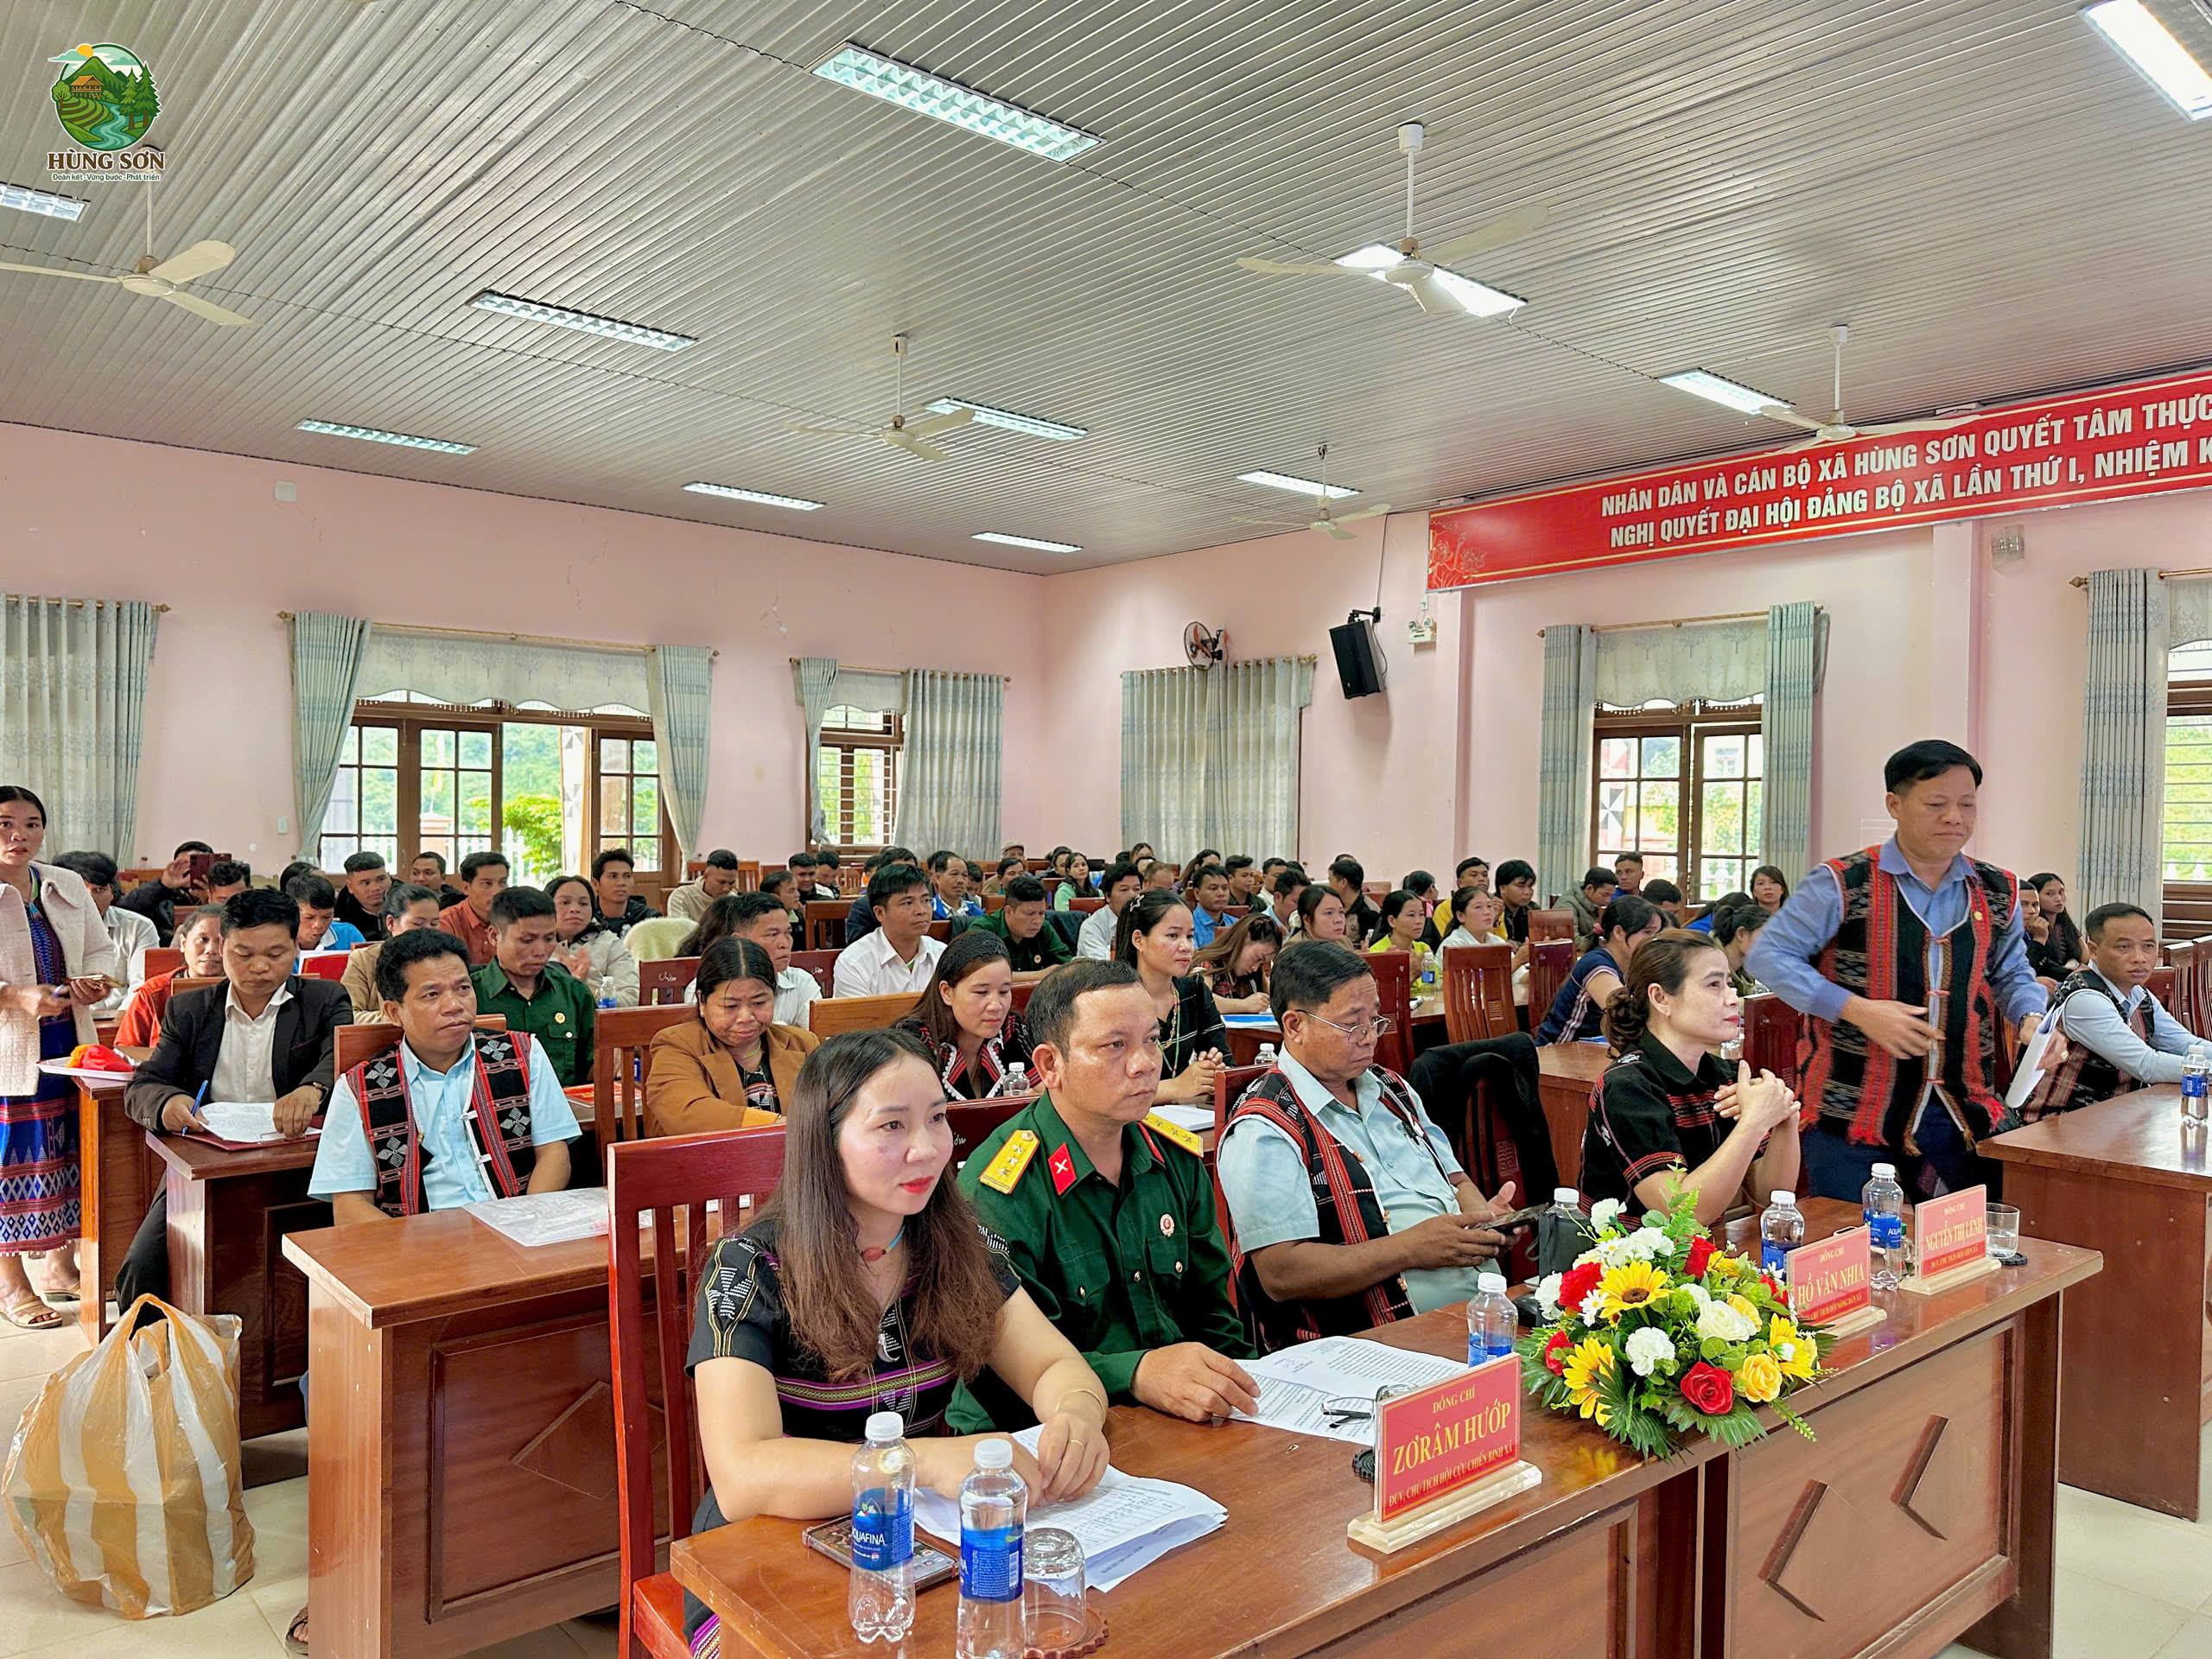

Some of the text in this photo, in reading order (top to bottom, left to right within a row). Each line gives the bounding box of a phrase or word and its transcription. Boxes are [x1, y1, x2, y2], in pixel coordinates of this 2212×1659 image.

[1601, 393, 2212, 517] NHÂN DÂN VÀ CÁN BỘ XÃ HÙNG SƠN QUYẾT TÂM THỰC
[1610, 521, 1655, 548] NGHỊ
[1660, 505, 1719, 542] QUYẾT
[1725, 508, 1759, 533] ĐẠI
[1765, 496, 1800, 528] HỘI
[1807, 486, 1867, 519] ĐẢNG
[1875, 479, 1905, 512] BỘ
[1913, 474, 1946, 505] XÃ
[1953, 462, 2001, 499] LẦN
[2010, 454, 2063, 491] THỨ
[2069, 457, 2084, 485] I,
[2094, 438, 2189, 479] NHIỆM
[1797, 1262, 1865, 1306] HỒ VĂN NHIA
[1433, 1383, 1476, 1414] ĐỒNG CHÍ
[1393, 1397, 1511, 1476] ZƠRÂM HƯỚP
[1406, 1478, 1421, 1498] CHỦ
[1422, 1476, 1439, 1493] TỊCH
[1440, 1467, 1452, 1485] HỘI
[1467, 1452, 1487, 1471] CHIẾN
[1488, 1446, 1503, 1462] BINH
